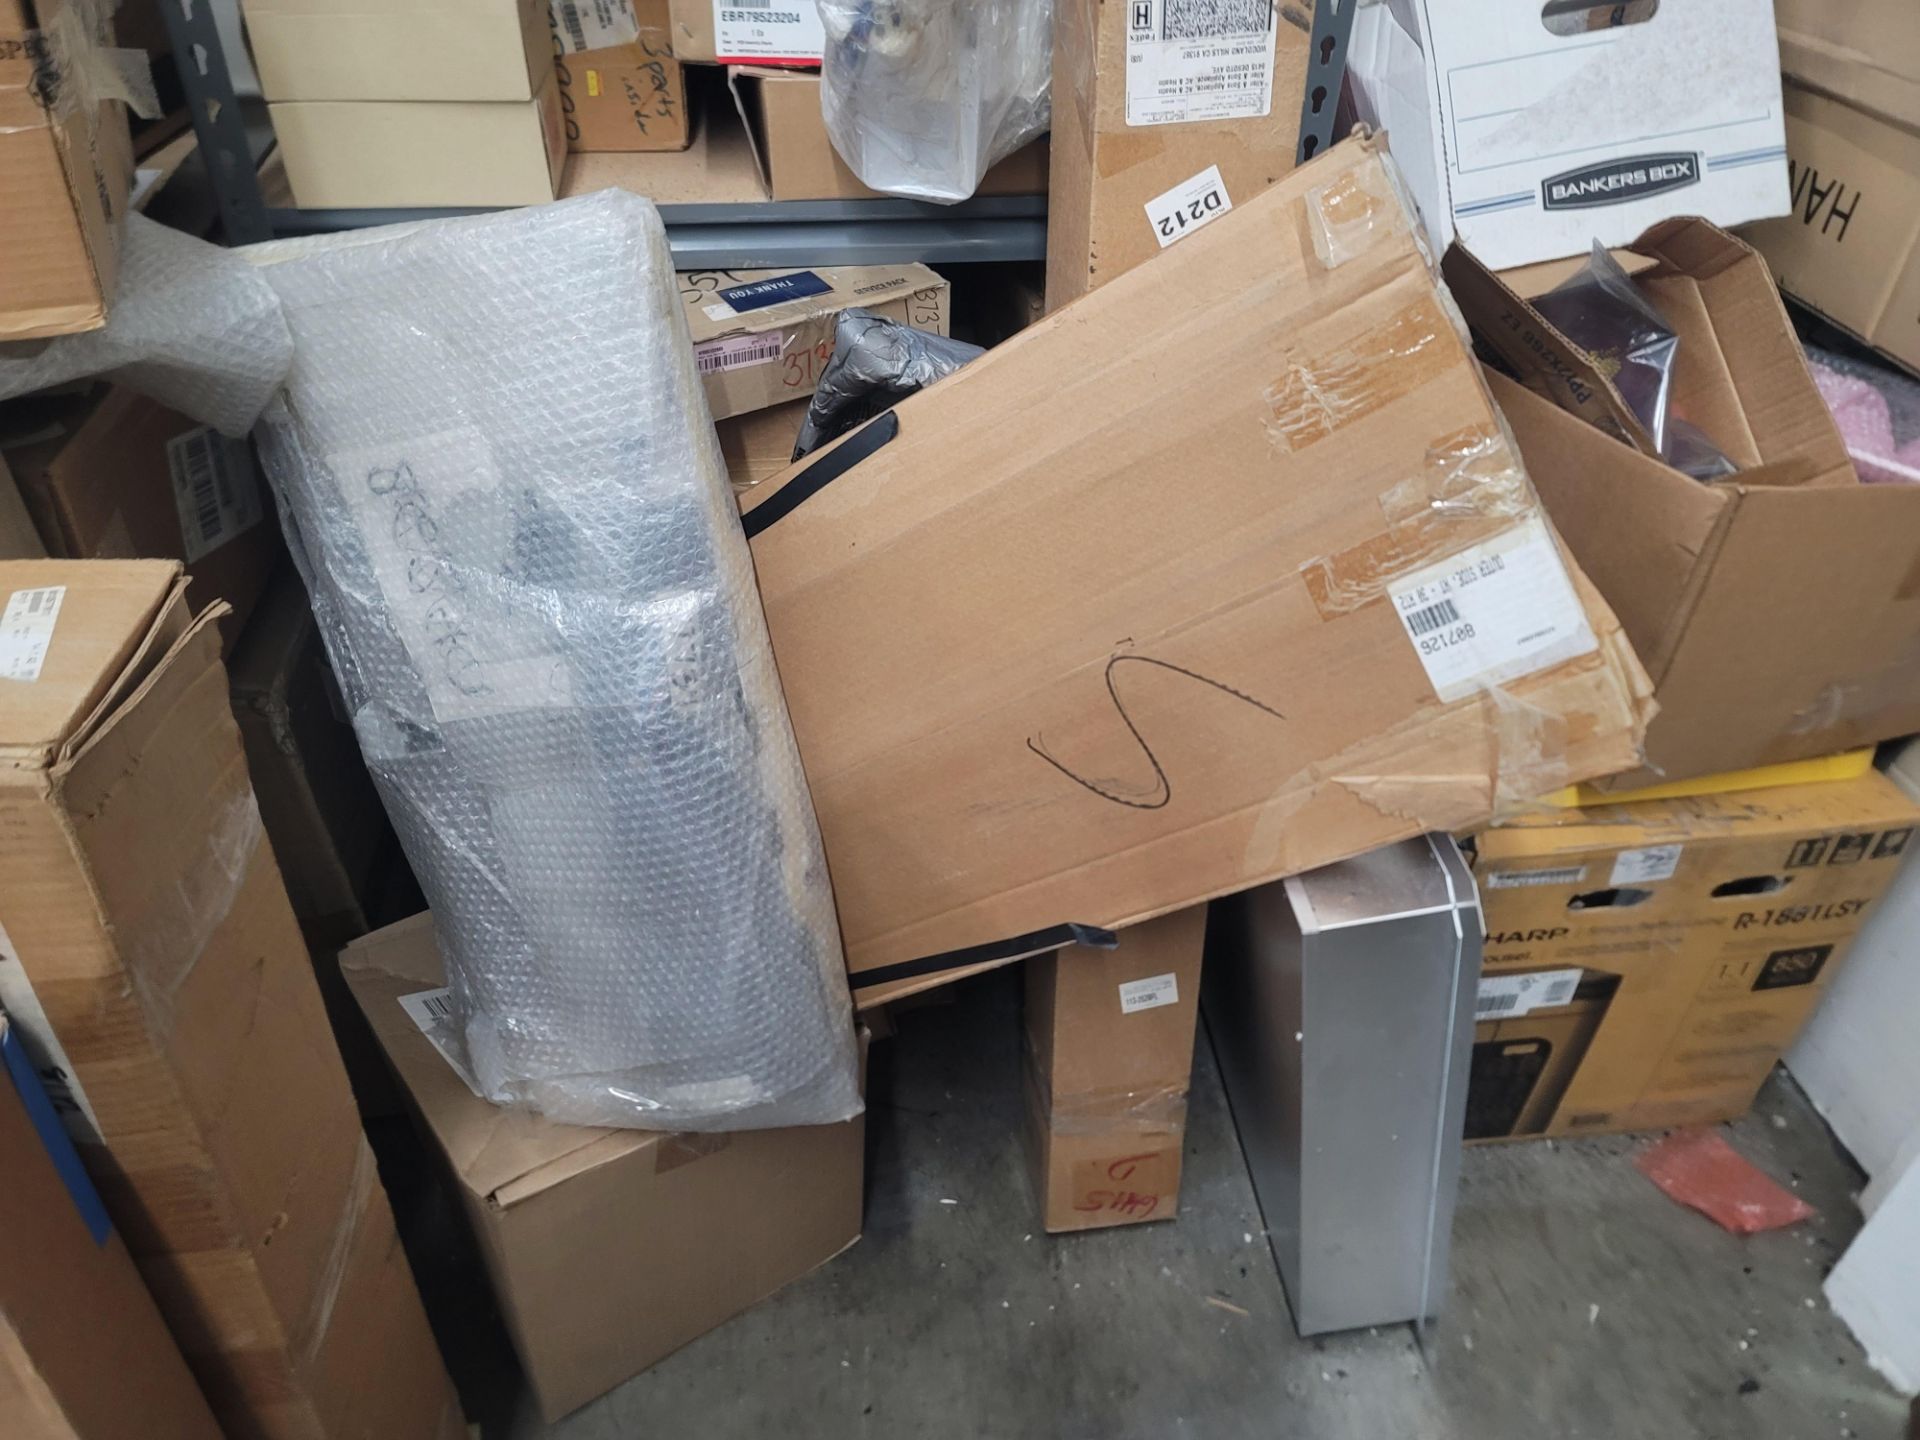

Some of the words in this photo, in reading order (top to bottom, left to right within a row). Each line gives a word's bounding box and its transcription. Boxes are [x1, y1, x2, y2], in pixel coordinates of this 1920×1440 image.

[721, 10, 801, 23] EBR79523204
[1135, 4, 1149, 26] H
[1551, 169, 1648, 201] BANKERS
[1649, 161, 1693, 182] BOX
[1157, 190, 1222, 236] D212
[728, 286, 756, 300] YOU
[756, 278, 795, 295] THANK
[853, 281, 885, 296] SERVICE
[885, 276, 909, 290] PACK
[1420, 624, 1476, 655] 807126
[1485, 928, 1569, 943] HARP
